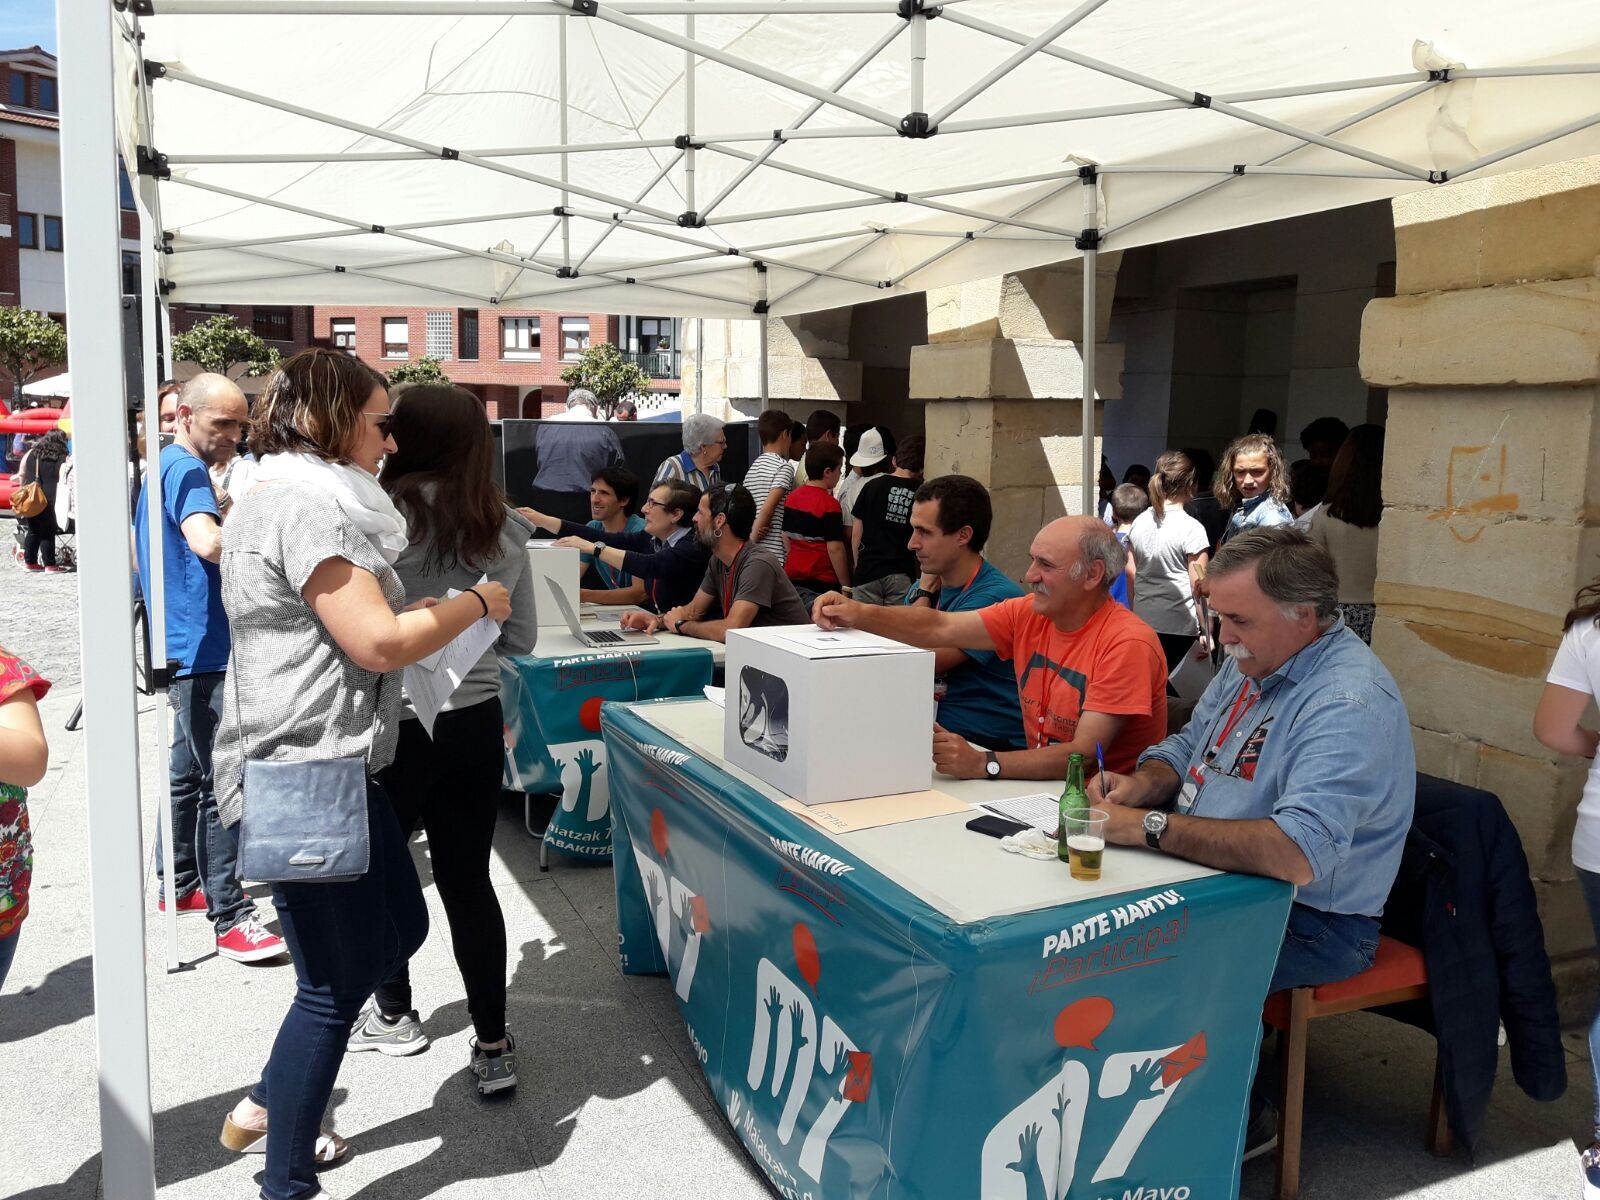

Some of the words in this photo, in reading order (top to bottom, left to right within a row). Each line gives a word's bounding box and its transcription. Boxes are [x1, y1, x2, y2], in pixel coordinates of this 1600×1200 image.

[548, 822, 601, 841] aiatzak
[769, 836, 802, 862] PARTE
[801, 847, 856, 877] HARTU!
[1042, 912, 1111, 958] PARTE
[1111, 888, 1185, 929] HARTU!
